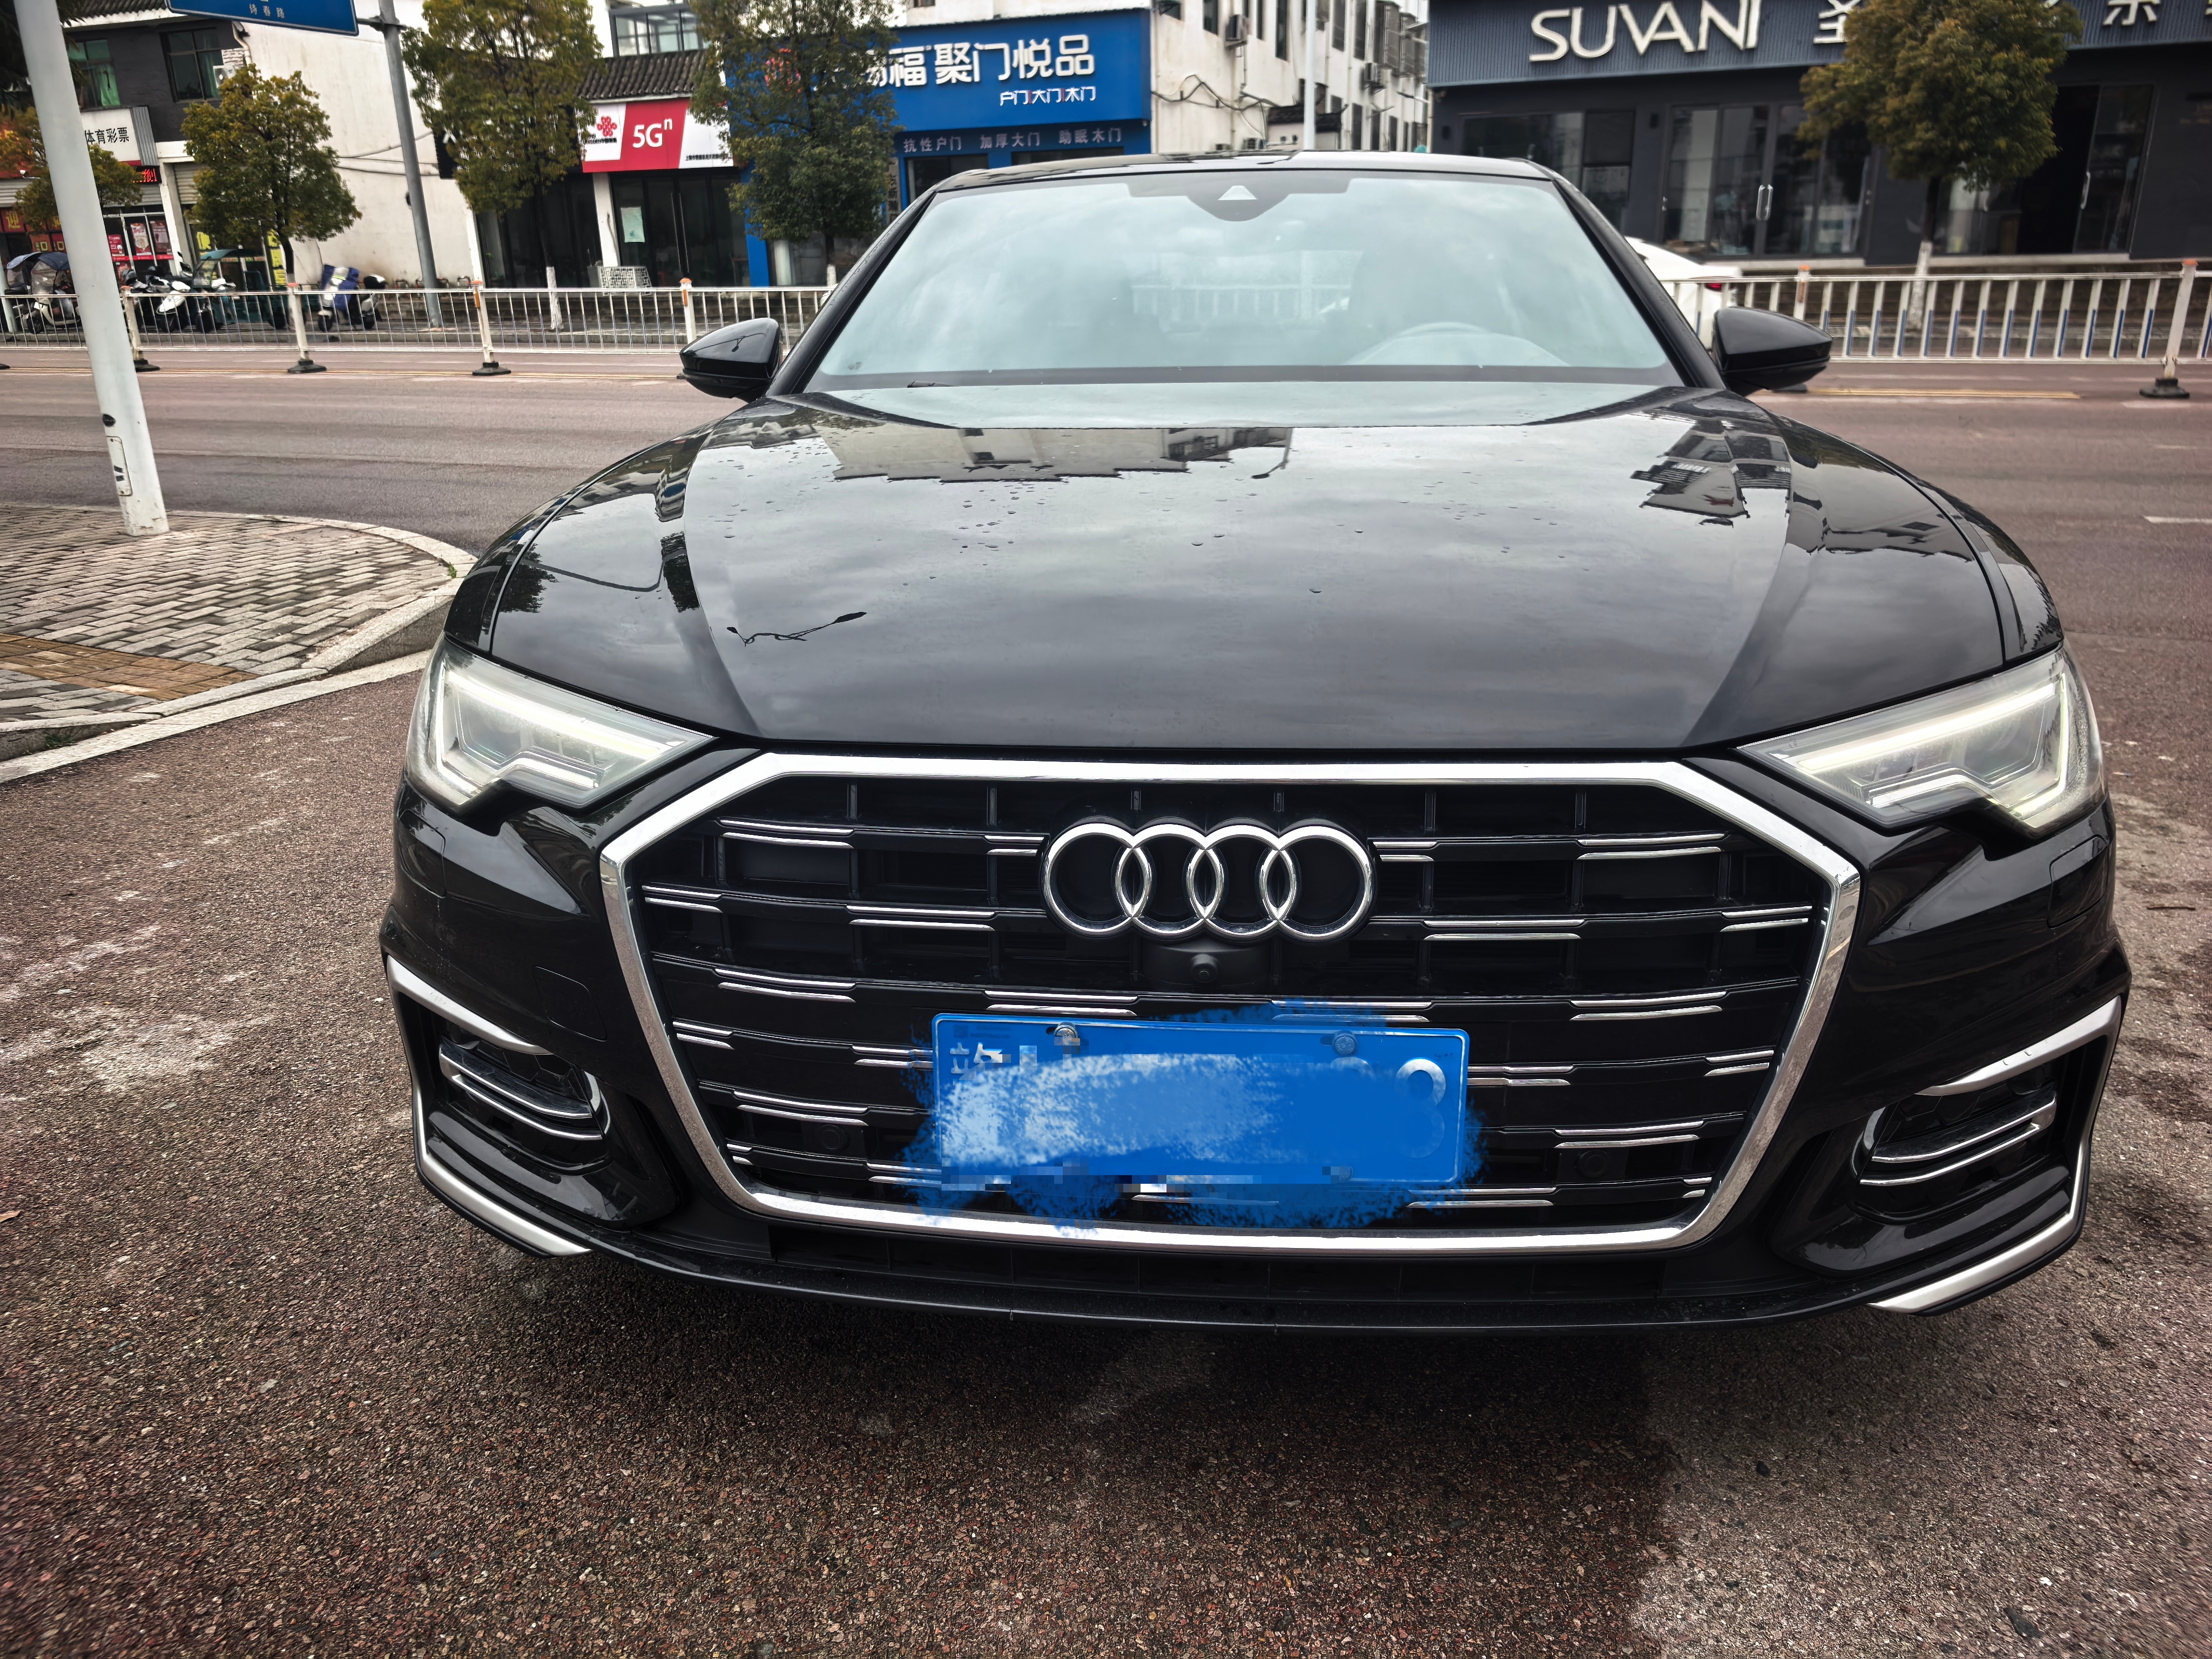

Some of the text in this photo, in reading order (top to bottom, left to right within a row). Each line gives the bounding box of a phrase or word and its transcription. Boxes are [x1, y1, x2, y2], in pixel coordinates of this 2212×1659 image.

[1529, 0, 1761, 62] SUVANI
[934, 34, 1095, 85] 聚门悦品
[980, 132, 1041, 150] 加厚大门
[1058, 127, 1122, 145] 助眠木门
